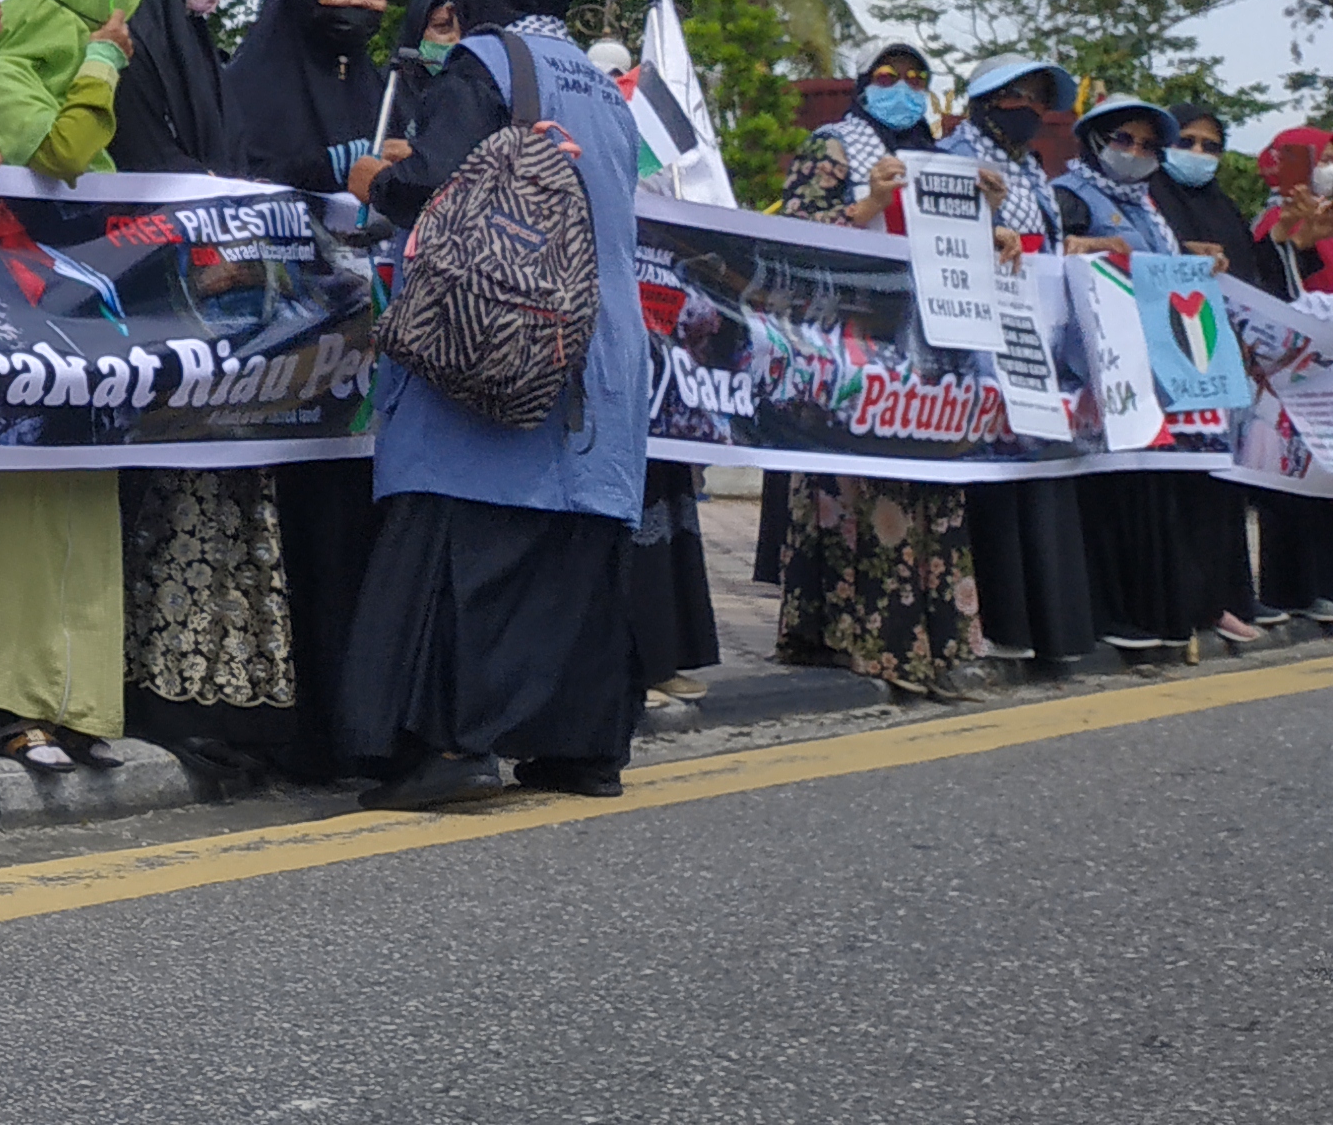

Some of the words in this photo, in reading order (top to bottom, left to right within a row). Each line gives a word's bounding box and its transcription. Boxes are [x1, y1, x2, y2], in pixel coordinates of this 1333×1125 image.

[921, 174, 976, 195] LIBERATE
[922, 195, 937, 212] AL
[938, 196, 977, 216] AQSHA
[105, 214, 183, 247] FREE
[175, 200, 314, 244] PALESTINE
[934, 235, 970, 260] CALL
[940, 267, 970, 291] FOR
[927, 297, 993, 321] KHILAFAH
[166, 334, 300, 408] Riau
[670, 345, 756, 418] Gaza
[853, 371, 974, 437] Patuhi
